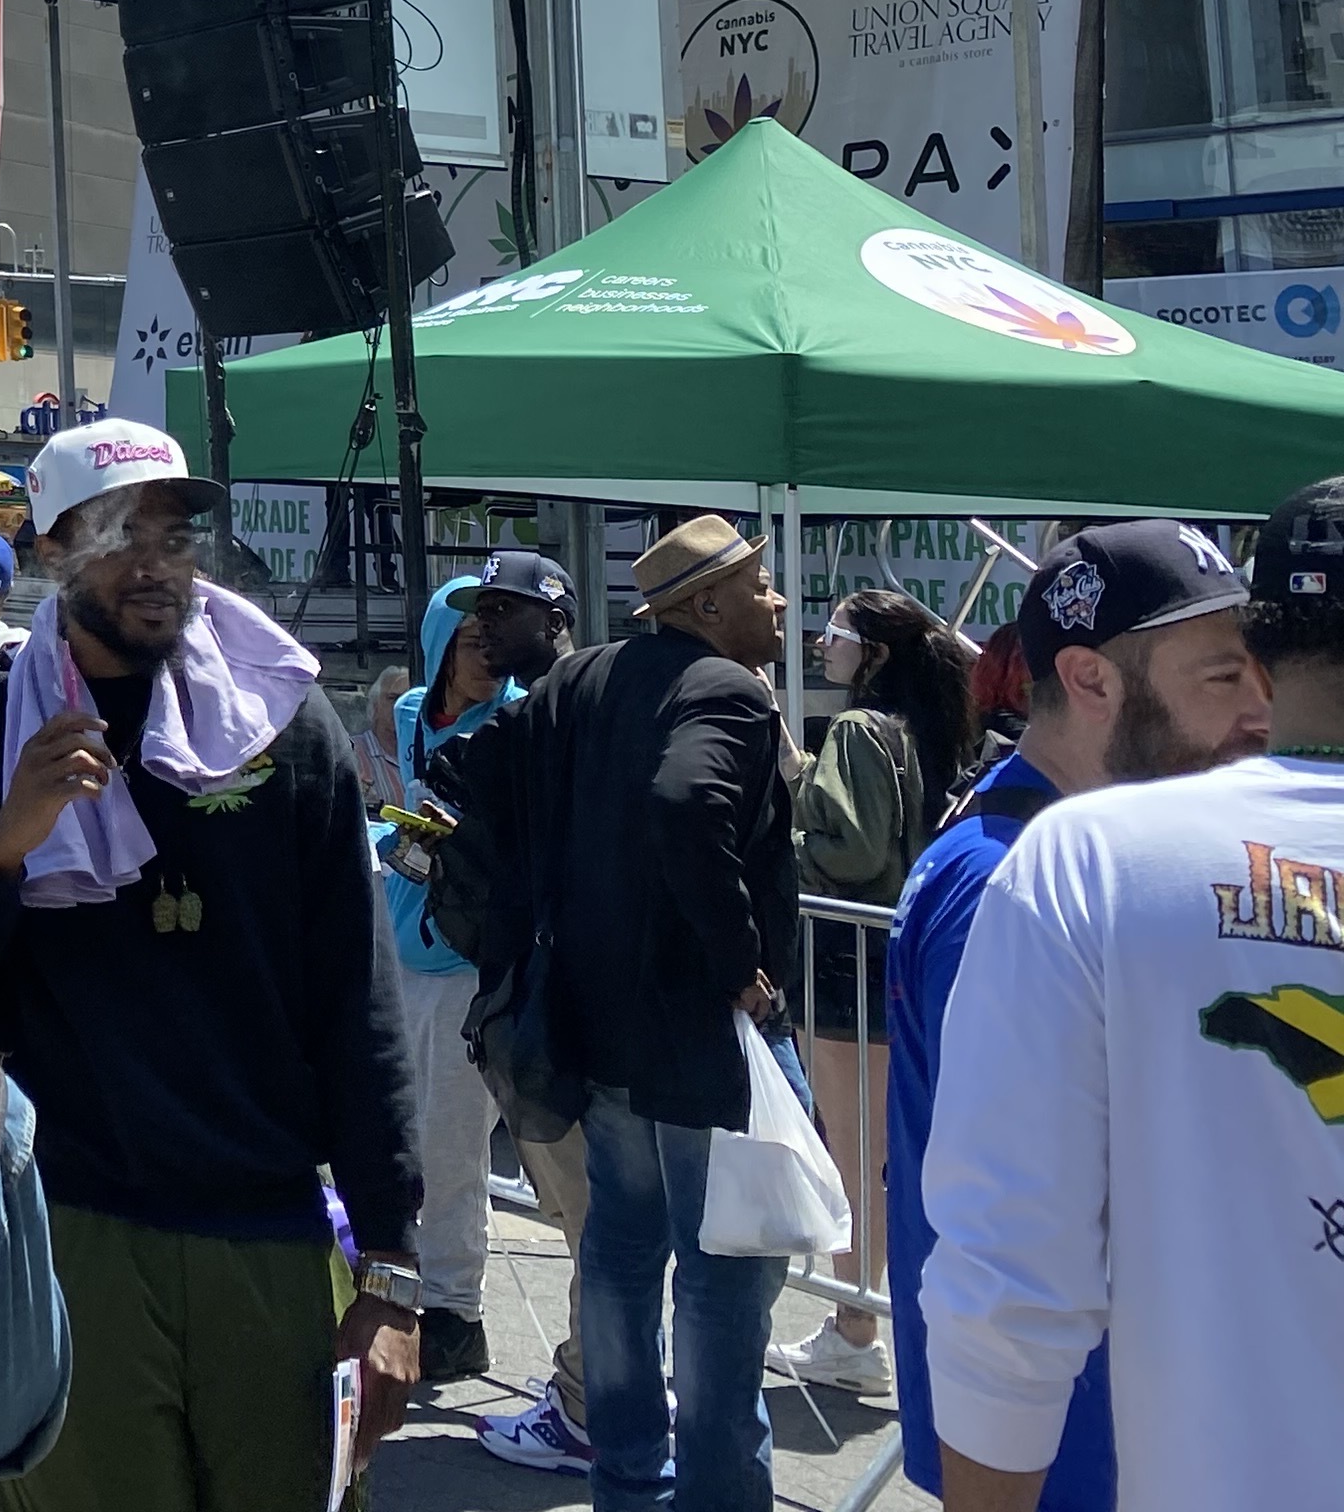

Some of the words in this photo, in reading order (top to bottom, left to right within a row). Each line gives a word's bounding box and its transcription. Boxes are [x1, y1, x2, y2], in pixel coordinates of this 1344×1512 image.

[716, 8, 776, 33] Cannabis
[848, 25, 934, 59] TRAVEL
[938, 5, 1054, 48] AGENY
[719, 29, 769, 57] NYC
[909, 51, 959, 66] cannabis
[963, 45, 993, 60] store
[907, 254, 993, 274] NYC
[600, 273, 678, 287] careers
[578, 287, 693, 301] businesses
[555, 301, 709, 314] neighborhoods
[1156, 305, 1267, 326] SOCOTEC
[176, 331, 252, 357] etin
[230, 498, 310, 535] PARADE
[1210, 839, 1344, 953] JA
